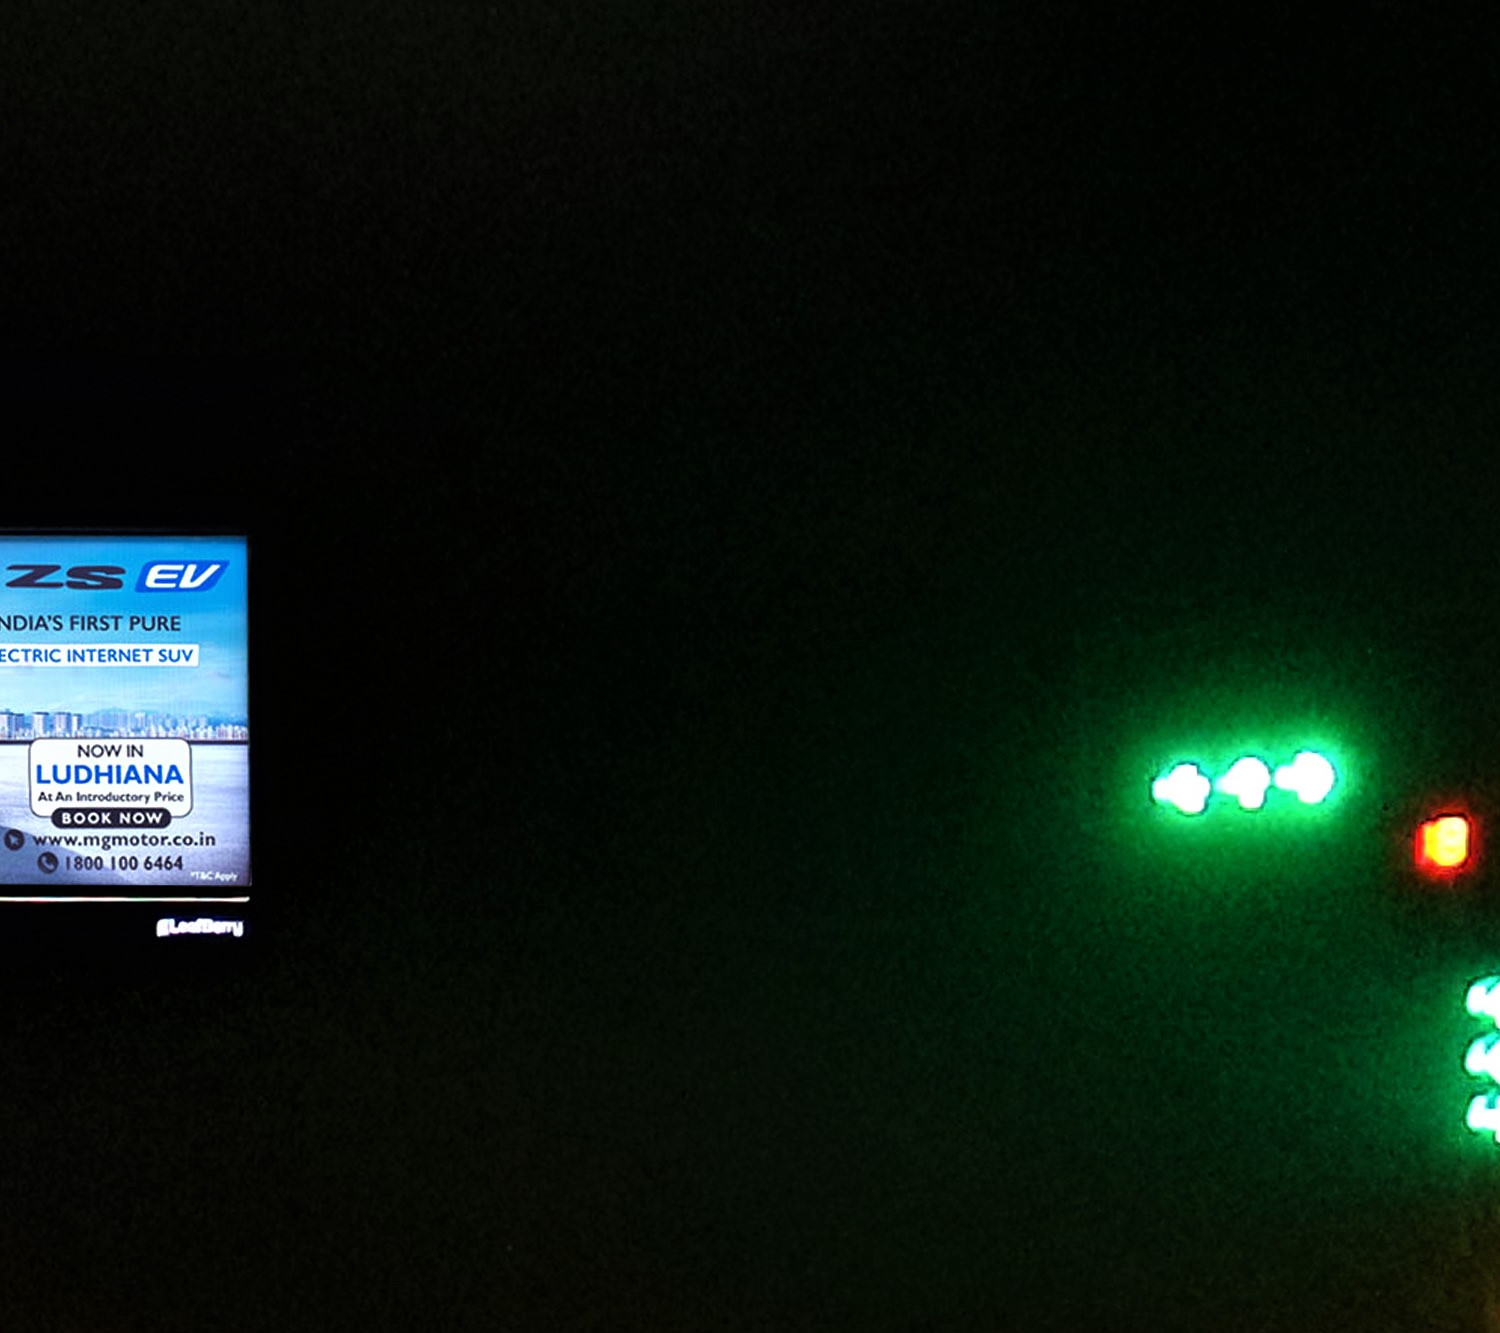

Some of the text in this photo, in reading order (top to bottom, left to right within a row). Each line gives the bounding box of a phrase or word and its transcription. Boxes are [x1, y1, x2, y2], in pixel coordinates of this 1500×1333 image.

[5, 564, 126, 590] ZS
[145, 563, 220, 588] EV
[69, 615, 123, 632] FIRST
[129, 615, 181, 632] PURE
[66, 648, 153, 663] INTERNET
[158, 648, 194, 663] SUV
[77, 744, 144, 758] NOW IN
[35, 764, 185, 785] LUDHIANA
[38, 791, 185, 805] At An Introductory Price
[61, 812, 163, 824] BOOK NOW
[33, 831, 217, 850] www.mgmotor.co.in
[65, 855, 184, 871] 1800 100 6464
